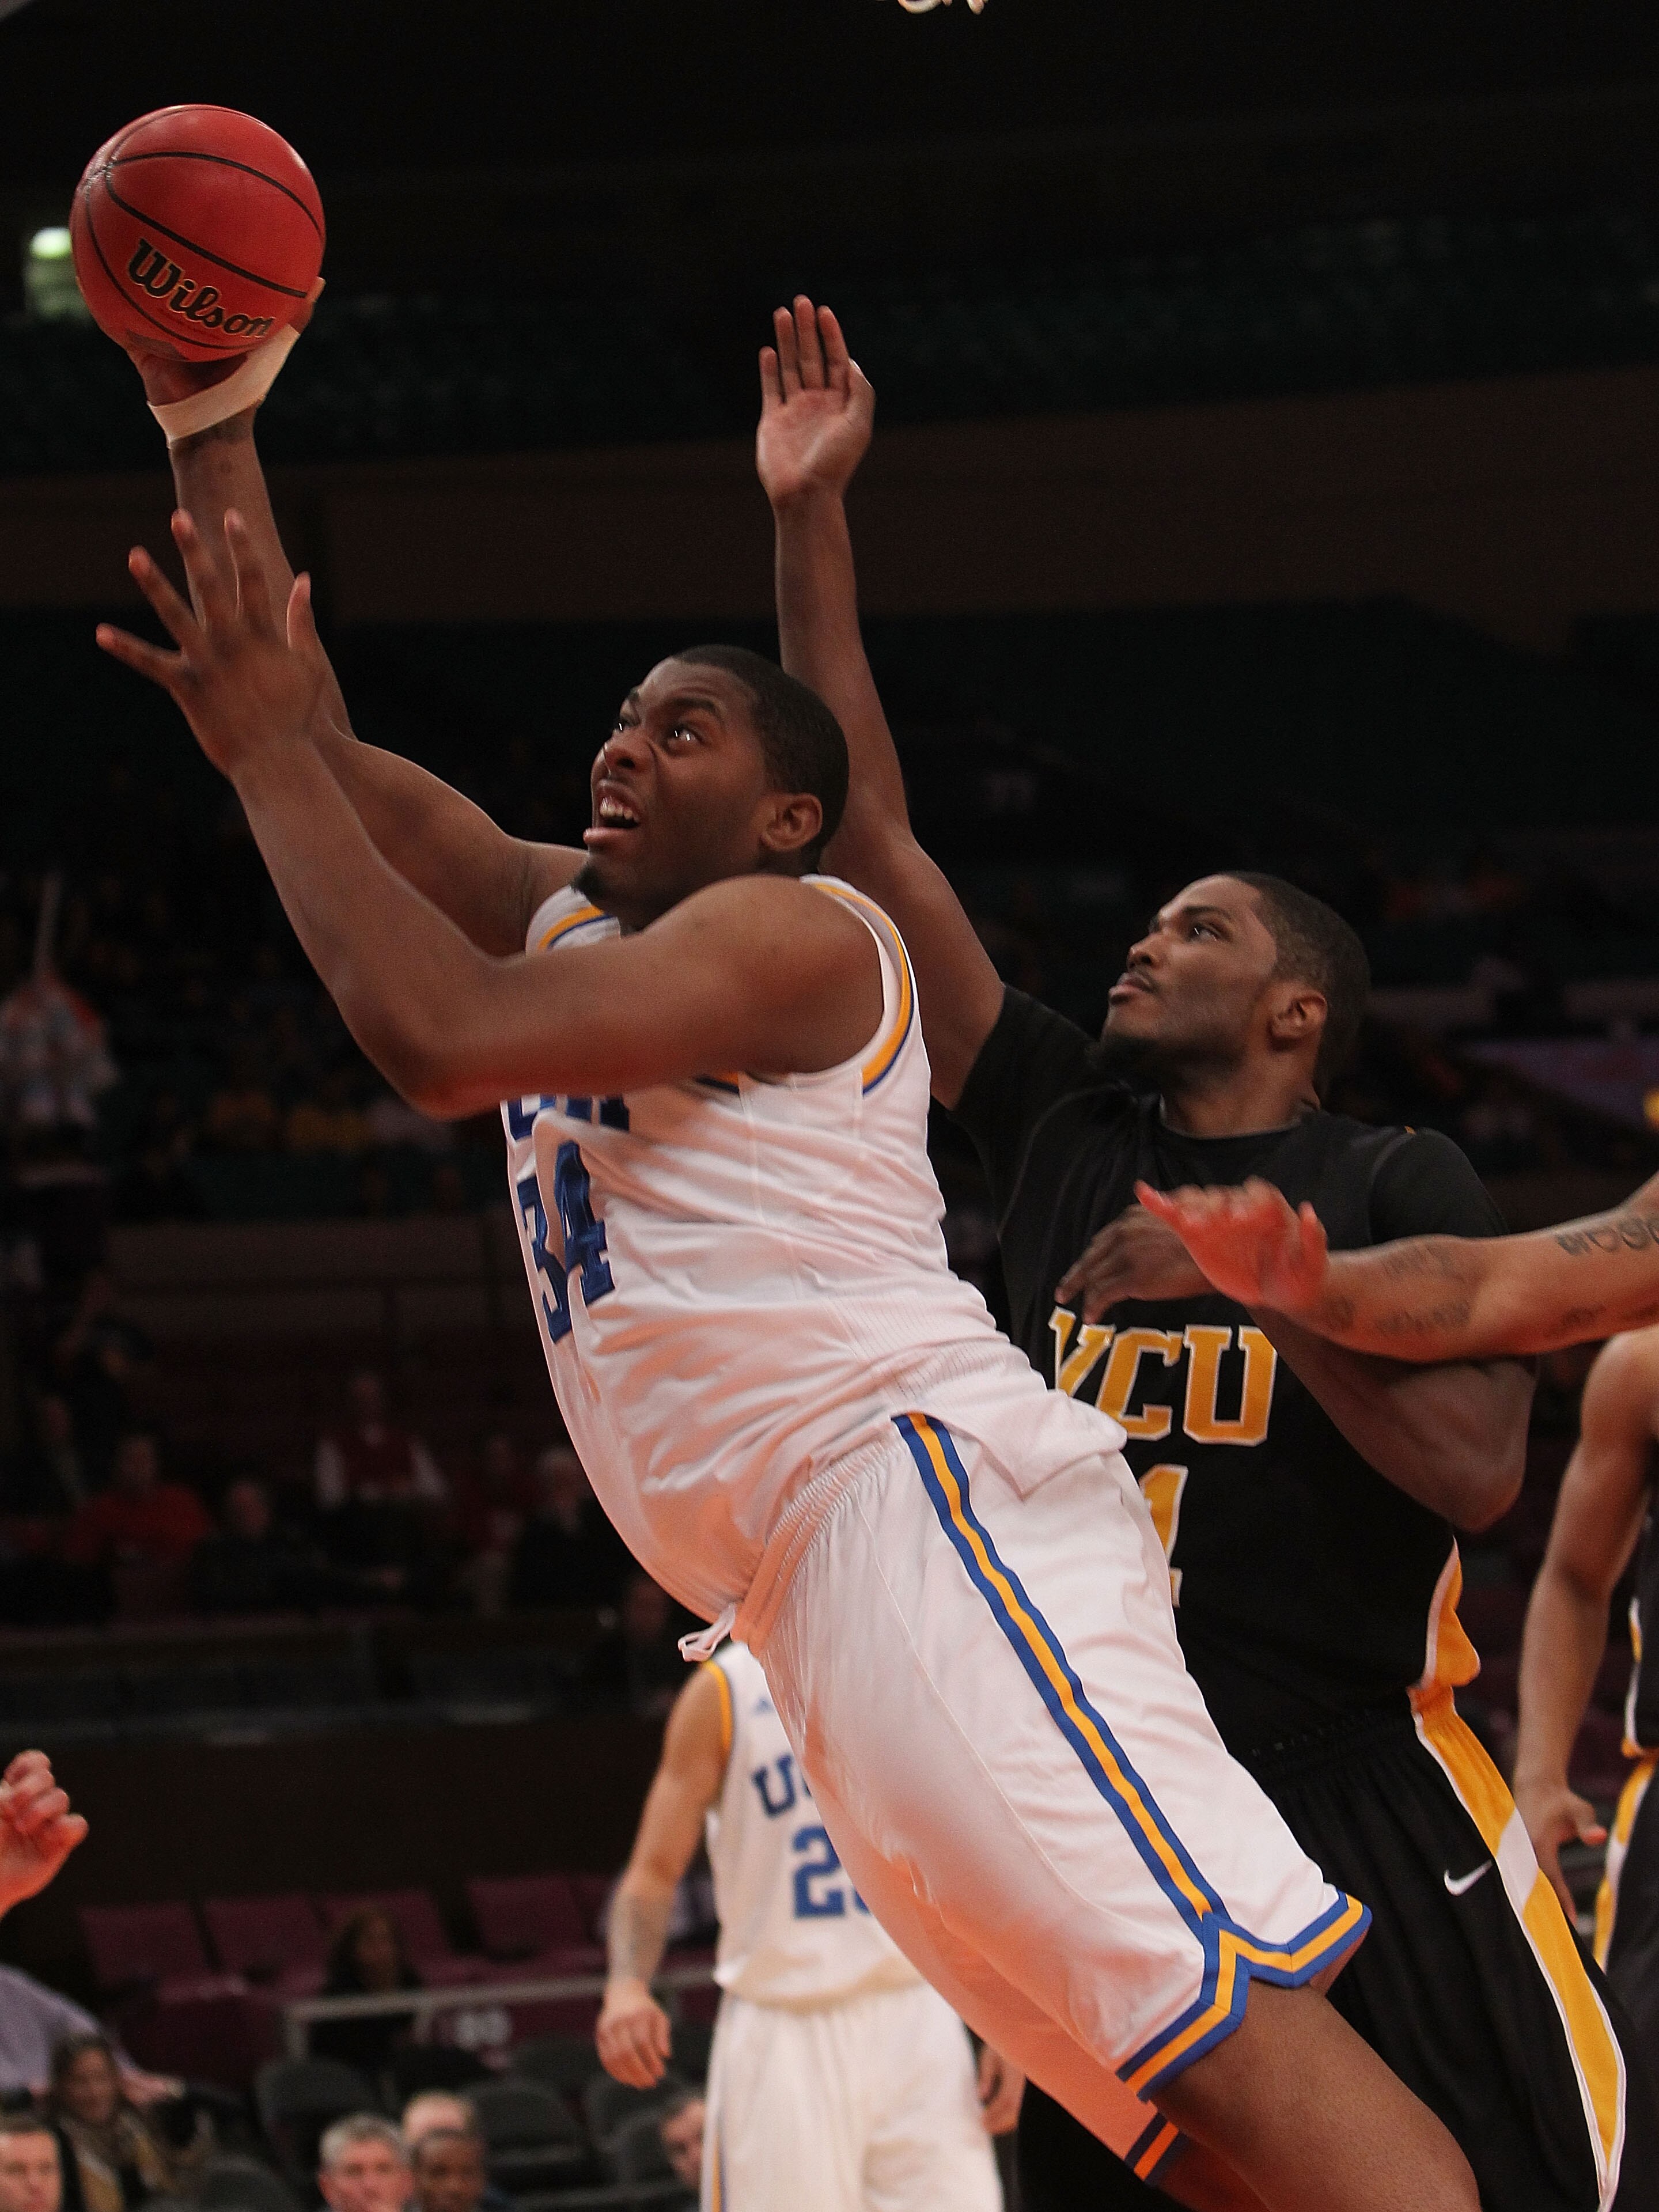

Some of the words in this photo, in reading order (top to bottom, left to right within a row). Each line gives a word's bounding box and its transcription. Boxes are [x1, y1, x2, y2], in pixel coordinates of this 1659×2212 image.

[128, 237, 275, 339] Wilson
[517, 1141, 616, 1344] 34
[1048, 1306, 1278, 1446] VCU
[792, 1825, 872, 1919] 2
